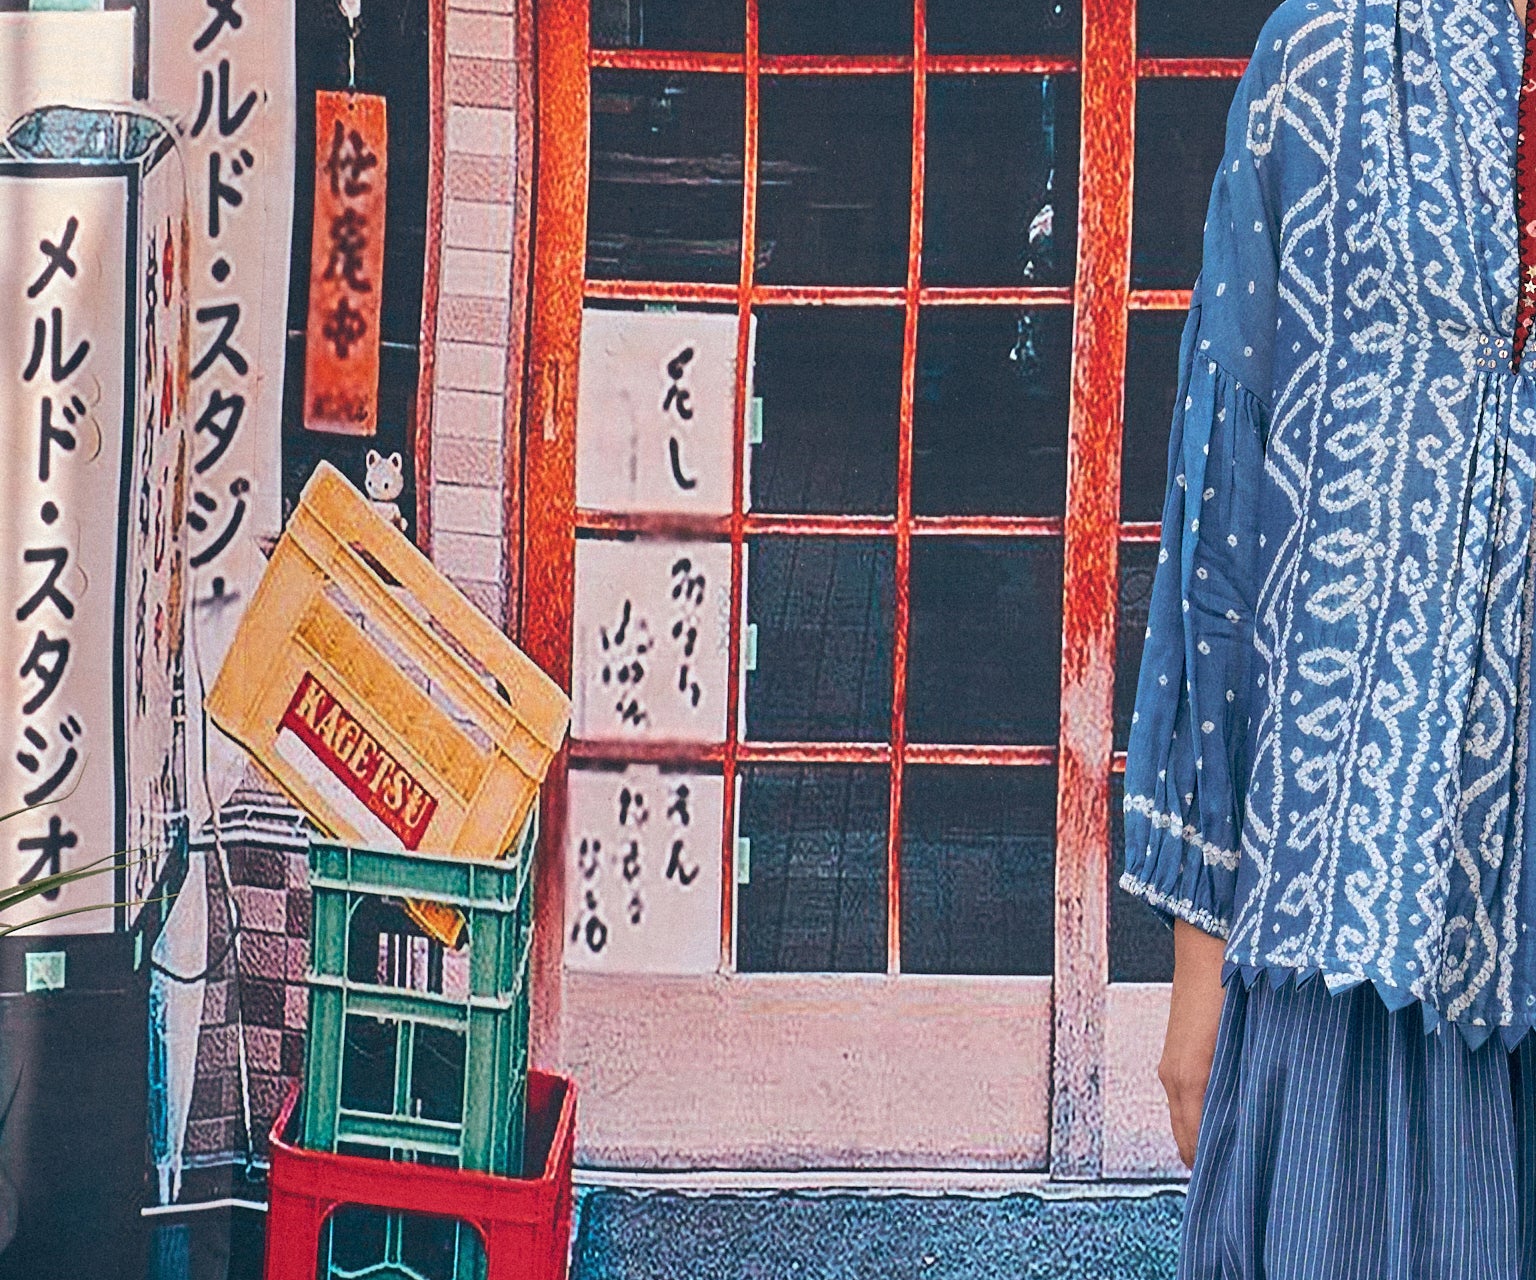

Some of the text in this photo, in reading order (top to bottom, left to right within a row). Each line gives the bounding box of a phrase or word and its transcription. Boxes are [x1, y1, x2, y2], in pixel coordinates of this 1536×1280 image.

[16, 216, 90, 902] メルド・スタジオ
[294, 679, 437, 830] KAGETSU
